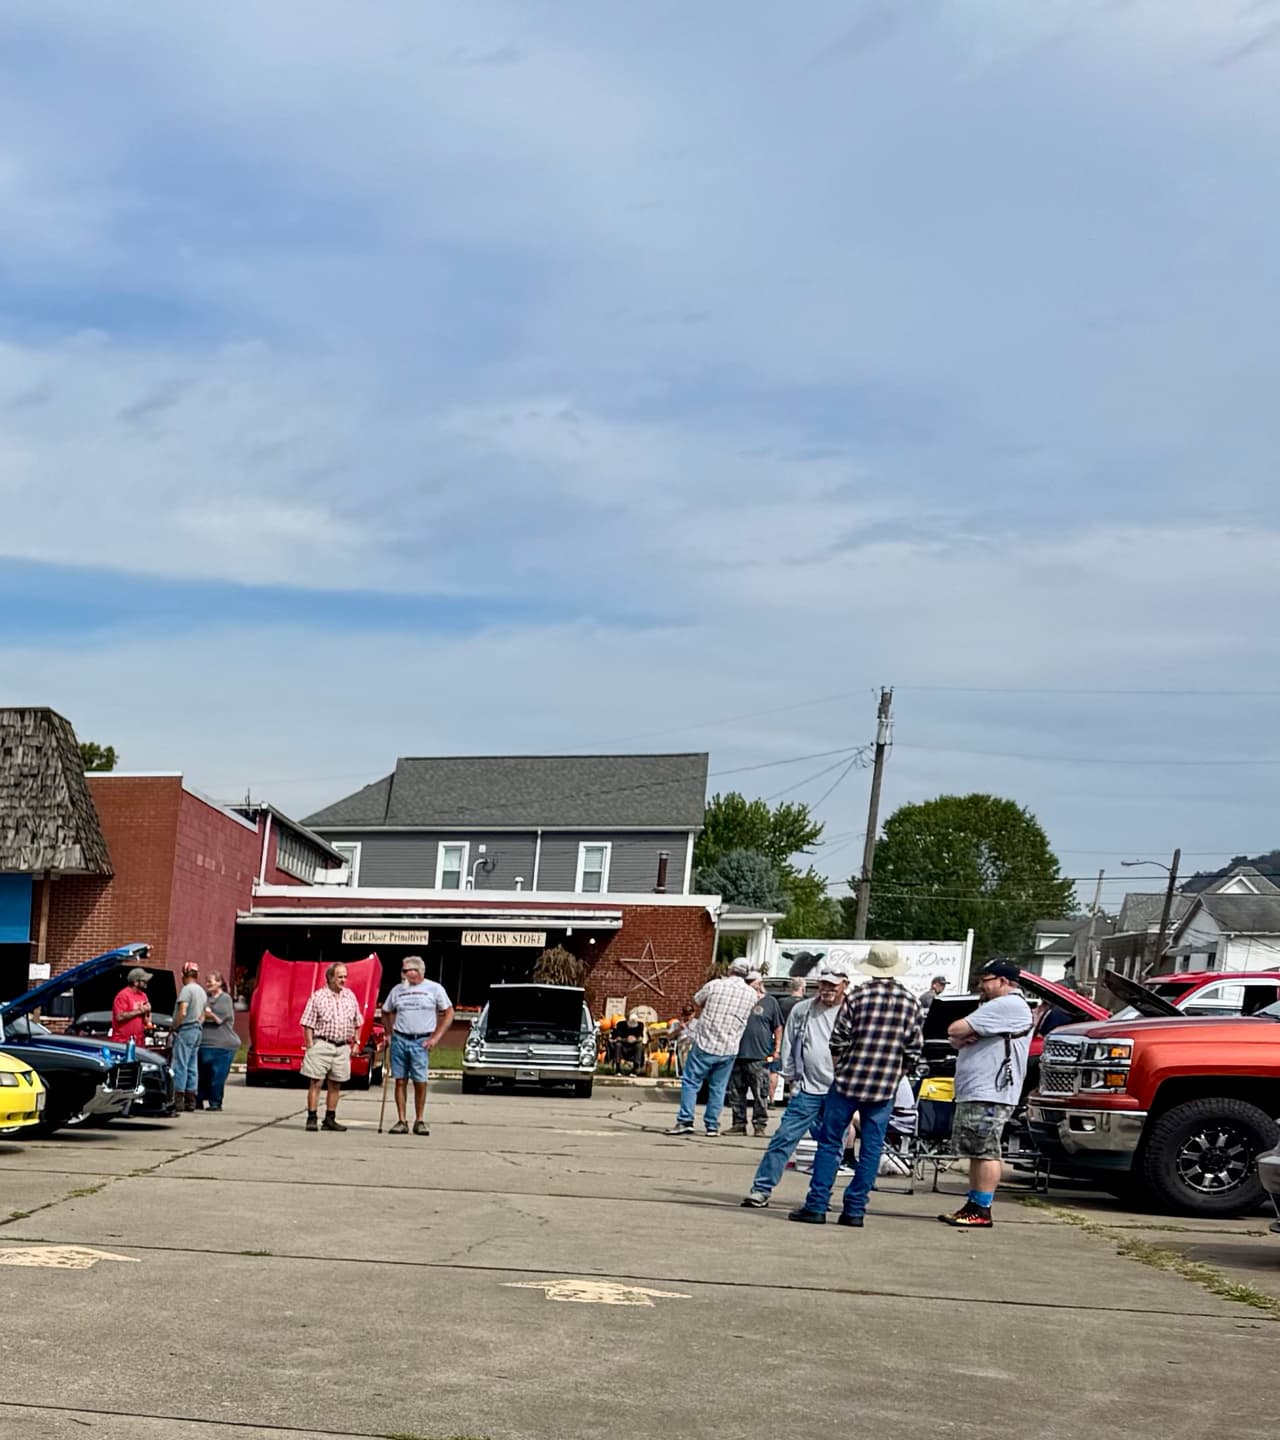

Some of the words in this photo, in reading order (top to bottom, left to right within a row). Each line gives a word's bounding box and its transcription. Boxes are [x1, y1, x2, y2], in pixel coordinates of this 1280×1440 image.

[343, 931, 366, 942] Cellar
[368, 931, 387, 942] Door
[464, 932, 508, 944] COUNTRY
[512, 933, 543, 945] STORE
